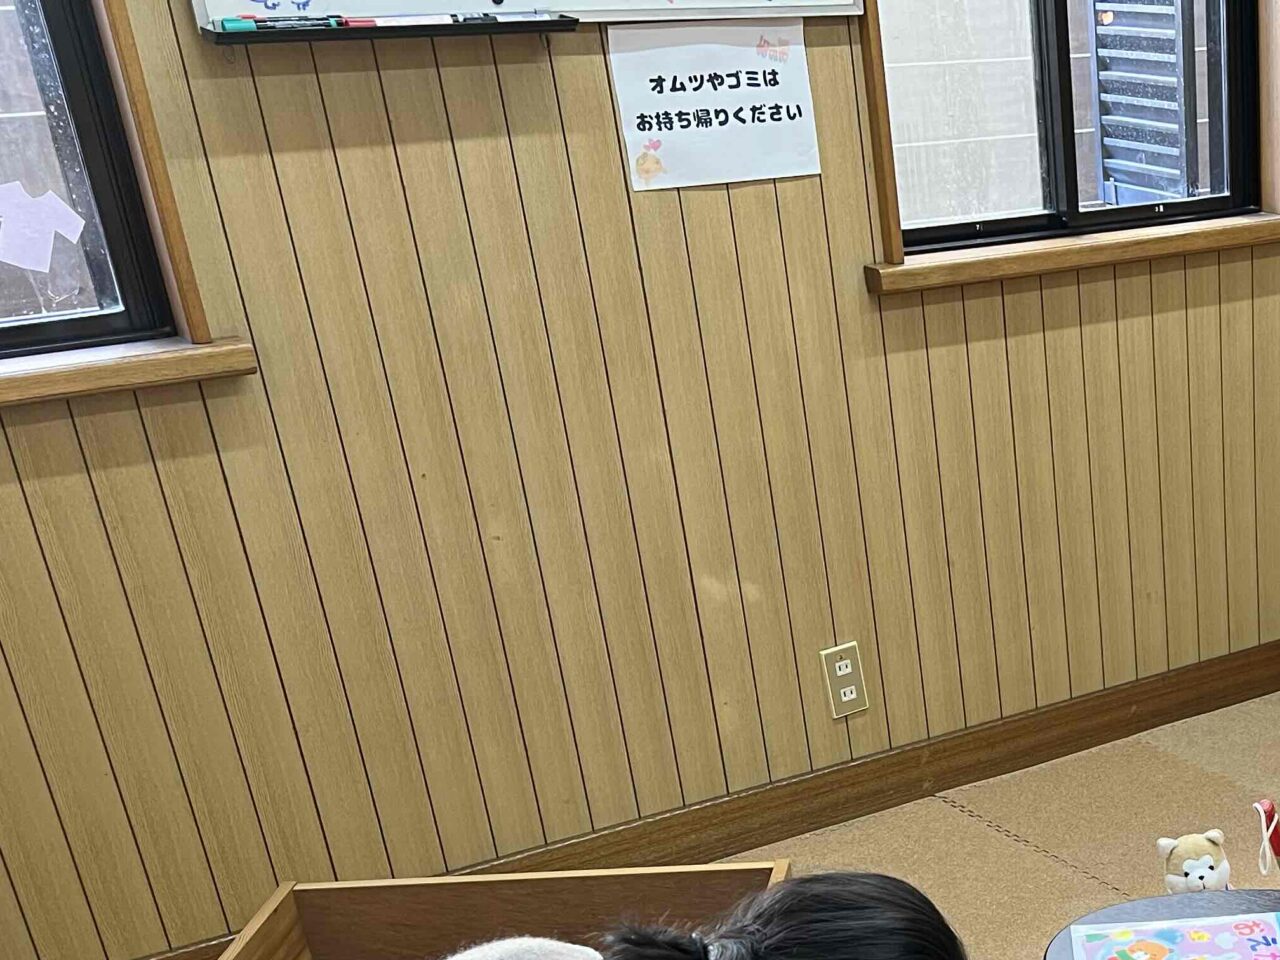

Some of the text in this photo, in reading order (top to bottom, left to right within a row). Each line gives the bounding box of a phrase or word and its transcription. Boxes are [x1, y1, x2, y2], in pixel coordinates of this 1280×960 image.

[649, 69, 779, 94] オムツやゴミは
[636, 103, 803, 132] お持ち帰りください
